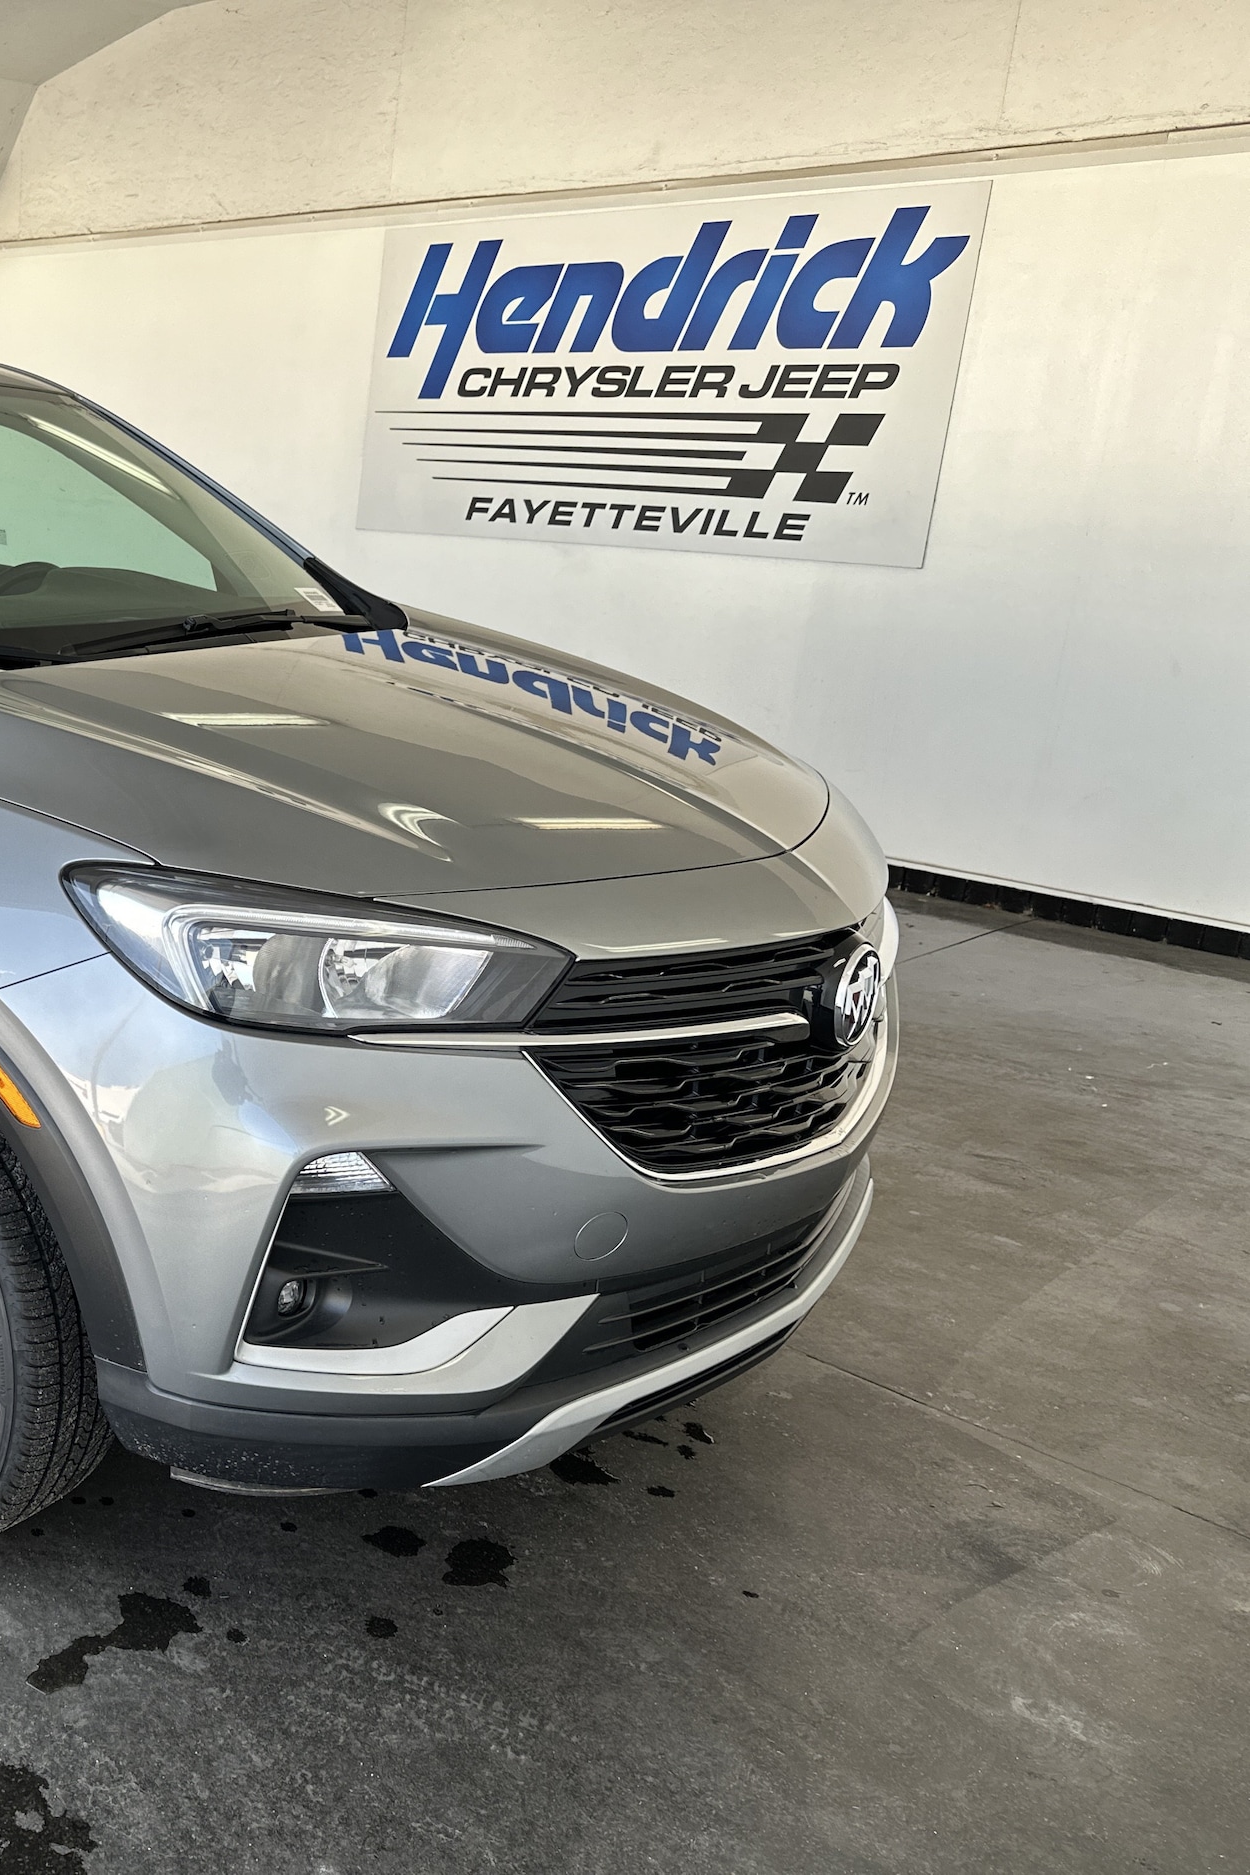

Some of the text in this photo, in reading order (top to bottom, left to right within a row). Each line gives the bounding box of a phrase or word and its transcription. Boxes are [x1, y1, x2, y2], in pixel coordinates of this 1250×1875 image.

[387, 206, 970, 399] Hendrick
[457, 363, 900, 398] CHRYSLER JEEP
[847, 492, 869, 505] TM
[465, 497, 811, 541] FAYETTEVILLE
